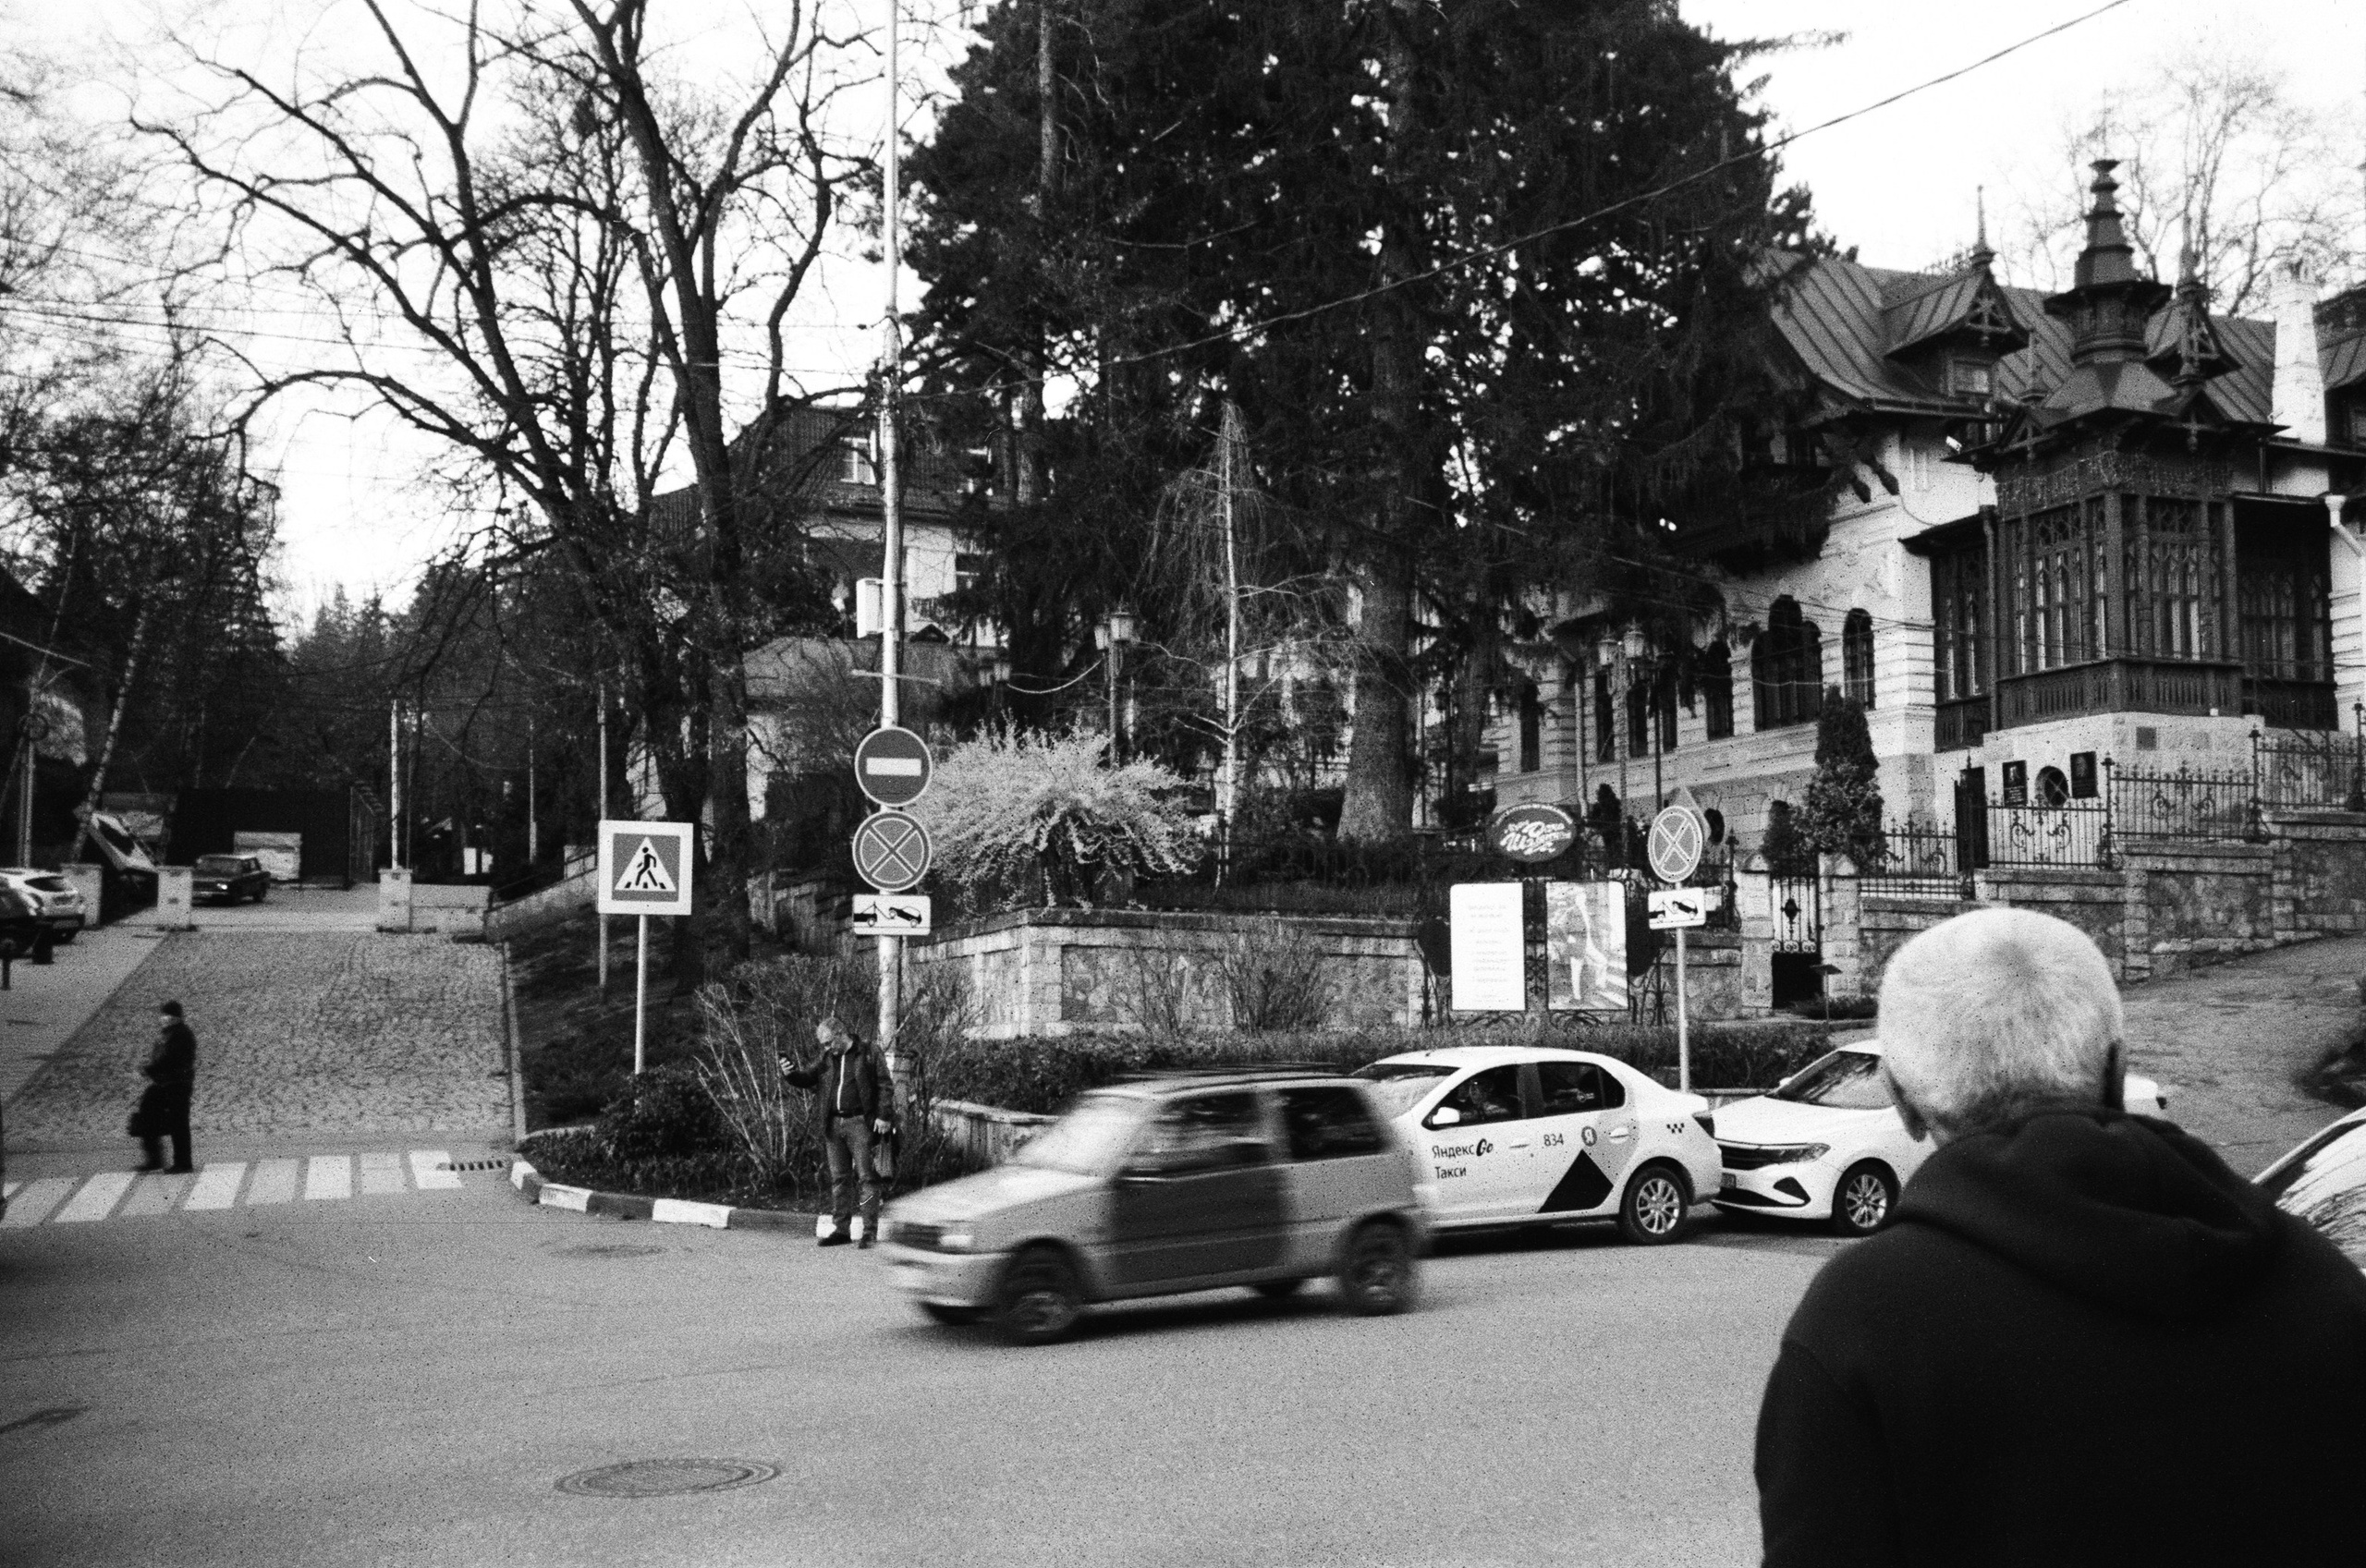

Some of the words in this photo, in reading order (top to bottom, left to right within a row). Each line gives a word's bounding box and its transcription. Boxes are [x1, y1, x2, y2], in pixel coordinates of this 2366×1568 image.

[1543, 1133, 1564, 1147] 834
[1432, 1145, 1474, 1159] Яндекс
[1476, 1137, 1494, 1157] Go
[1434, 1166, 1467, 1179] Такси
